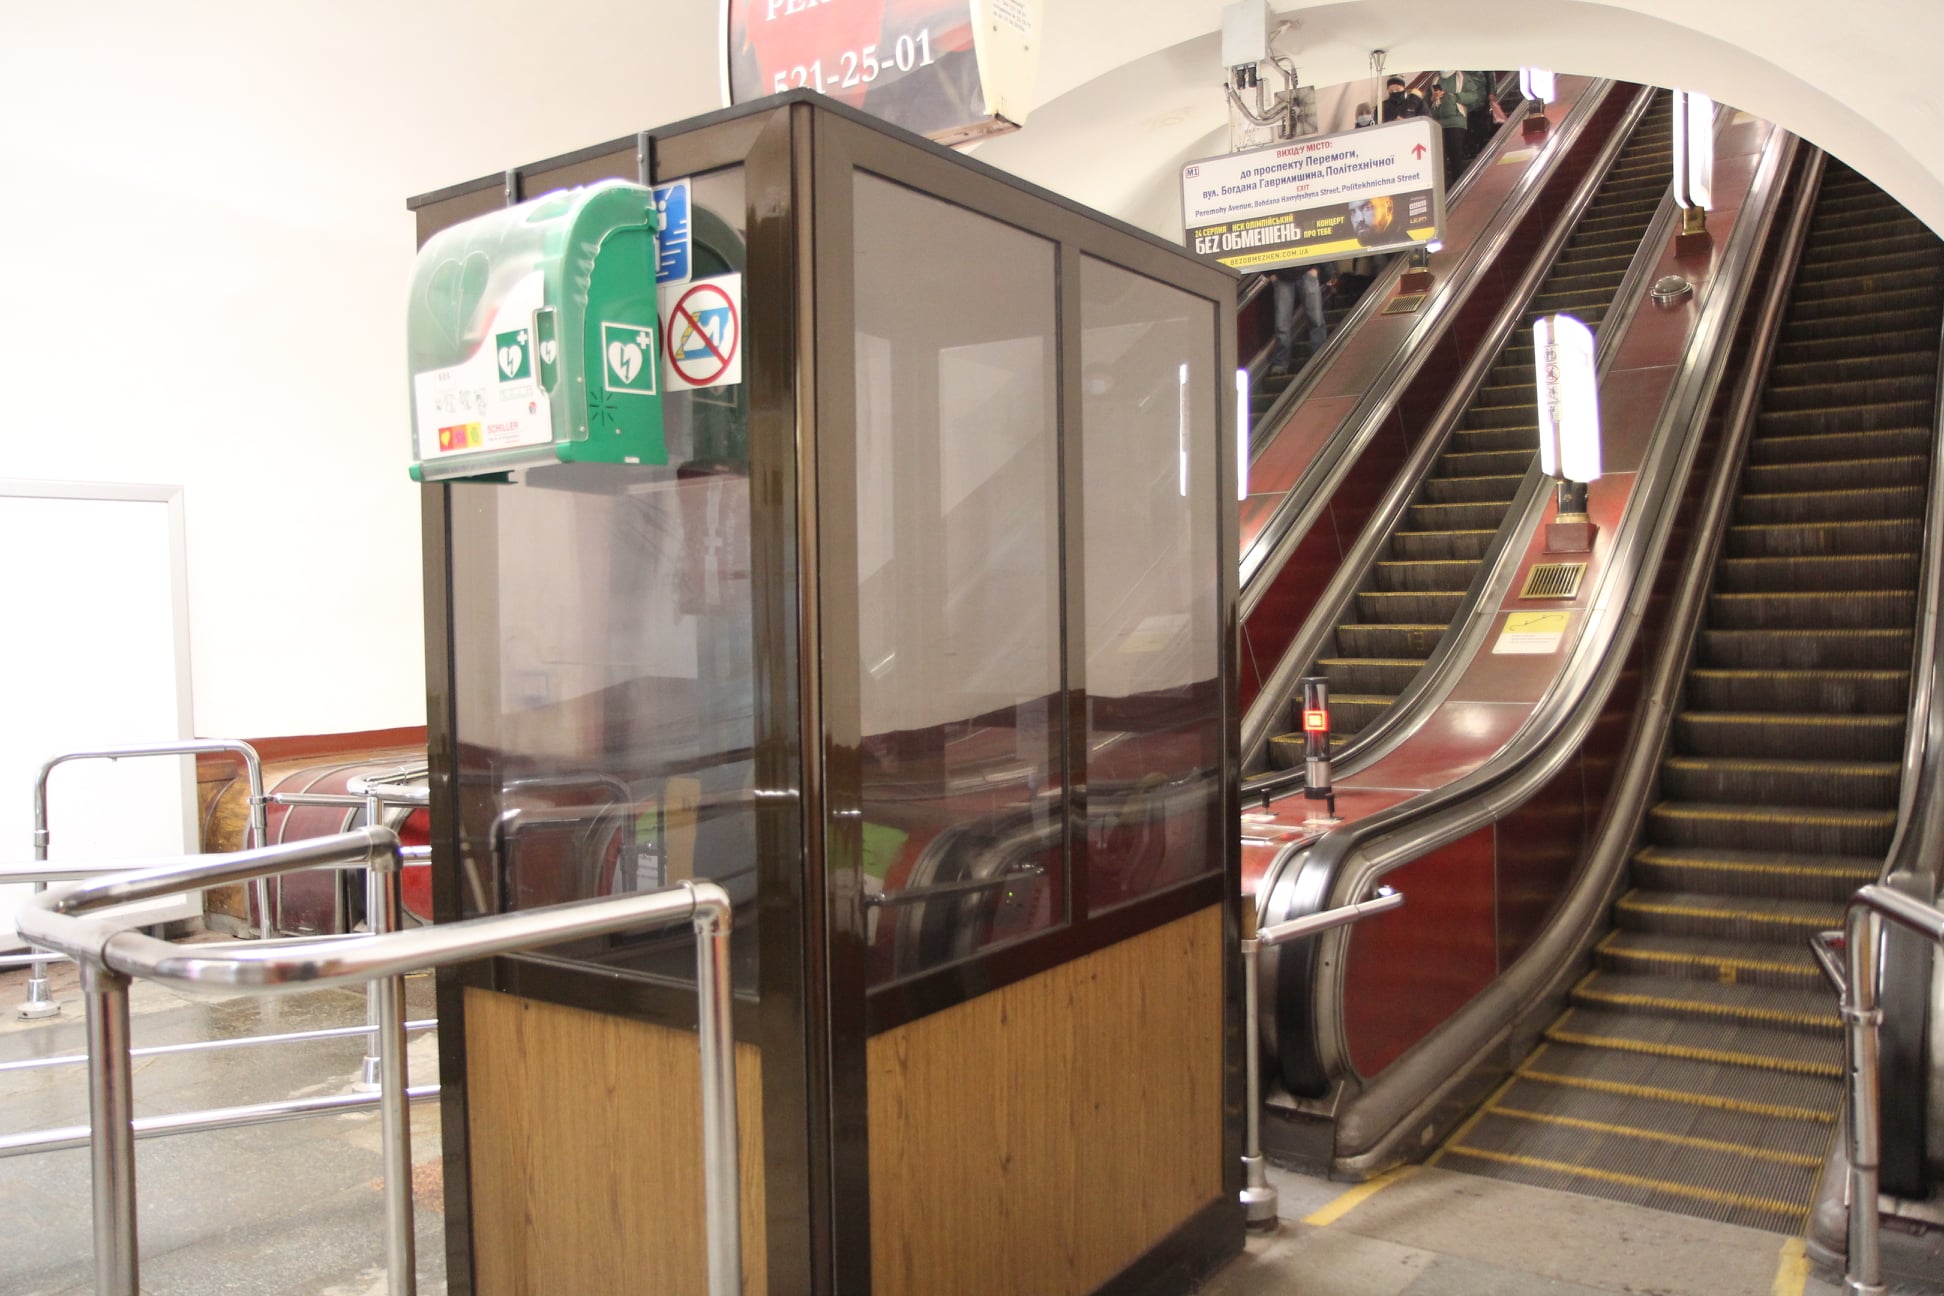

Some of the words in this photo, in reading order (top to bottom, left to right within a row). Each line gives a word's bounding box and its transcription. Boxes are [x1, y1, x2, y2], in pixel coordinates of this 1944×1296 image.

[774, 28, 934, 95] 521-25-01
[1276, 147, 1300, 158] ВИХІД
[1306, 141, 1333, 152] МІСТО:
[1240, 170, 1252, 180] до
[1254, 160, 1303, 178] проспекту
[1306, 150, 1359, 167] Перемоги,
[1202, 190, 1219, 200] вул.
[1221, 182, 1257, 196] Богдана
[1259, 170, 1325, 188] Гаврилишина,
[1325, 154, 1395, 177] Політехнічної
[1296, 184, 1310, 192] EXIT
[1195, 206, 1227, 217] Peremohy
[1228, 201, 1253, 211] Avenue,
[1254, 197, 1280, 208] Bohdana
[1281, 191, 1319, 204] Havrylyshyna
[1320, 187, 1341, 196] Street,
[1341, 177, 1396, 192] Politekhnichna
[1397, 172, 1420, 183] Street
[1303, 228, 1316, 238] ПРО
[1317, 226, 1333, 236] ТЕБЕ
[1316, 216, 1344, 228] КОНЦЕРТ
